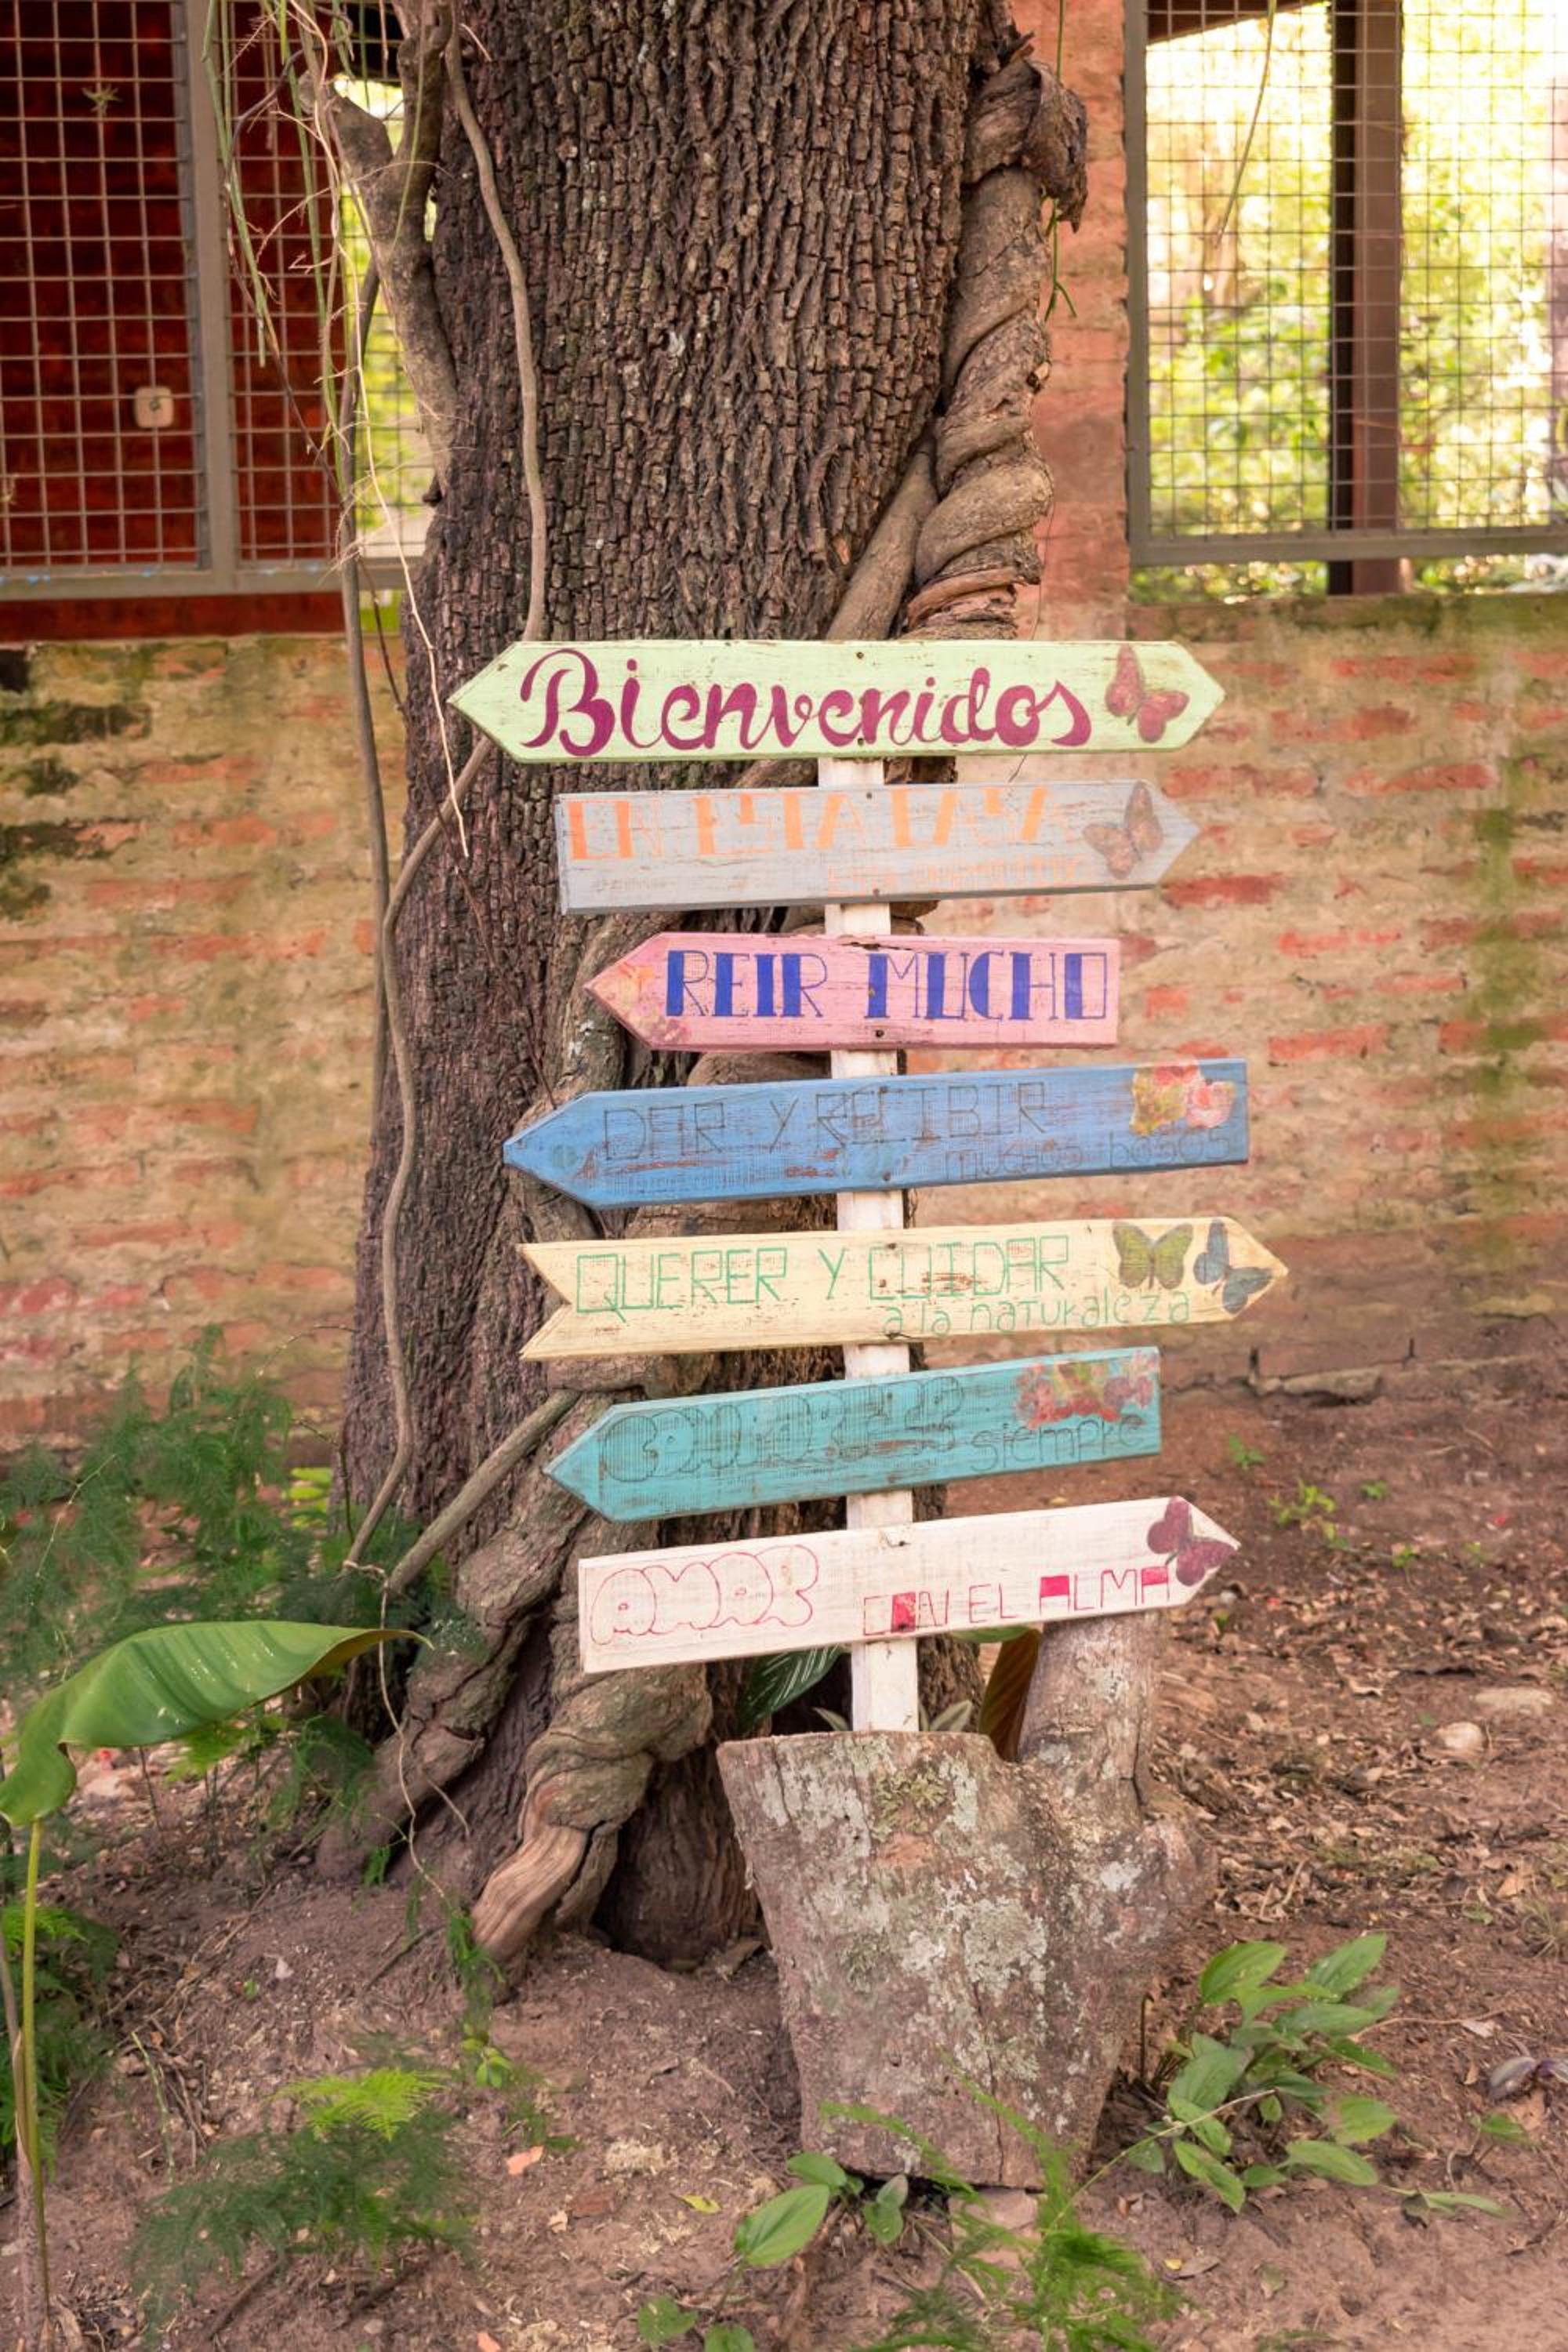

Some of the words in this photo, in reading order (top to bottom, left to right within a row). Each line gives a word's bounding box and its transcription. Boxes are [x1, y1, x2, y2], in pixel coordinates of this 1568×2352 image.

[520, 648, 1093, 757] Bienvenidos
[666, 949, 827, 1018] REIR
[864, 951, 1107, 1020] MUCHO
[604, 1102, 724, 1160] DAR
[770, 1098, 799, 1153] Y
[816, 1082, 1046, 1149] RECIBIR
[577, 1247, 787, 1323] QUERER
[818, 1247, 846, 1300] Y
[869, 1235, 1069, 1300] CUIDAR
[881, 1306, 904, 1334] a
[921, 1301, 952, 1336] la
[968, 1583, 1018, 1624] EL
[1039, 1566, 1170, 1616] ALMA
